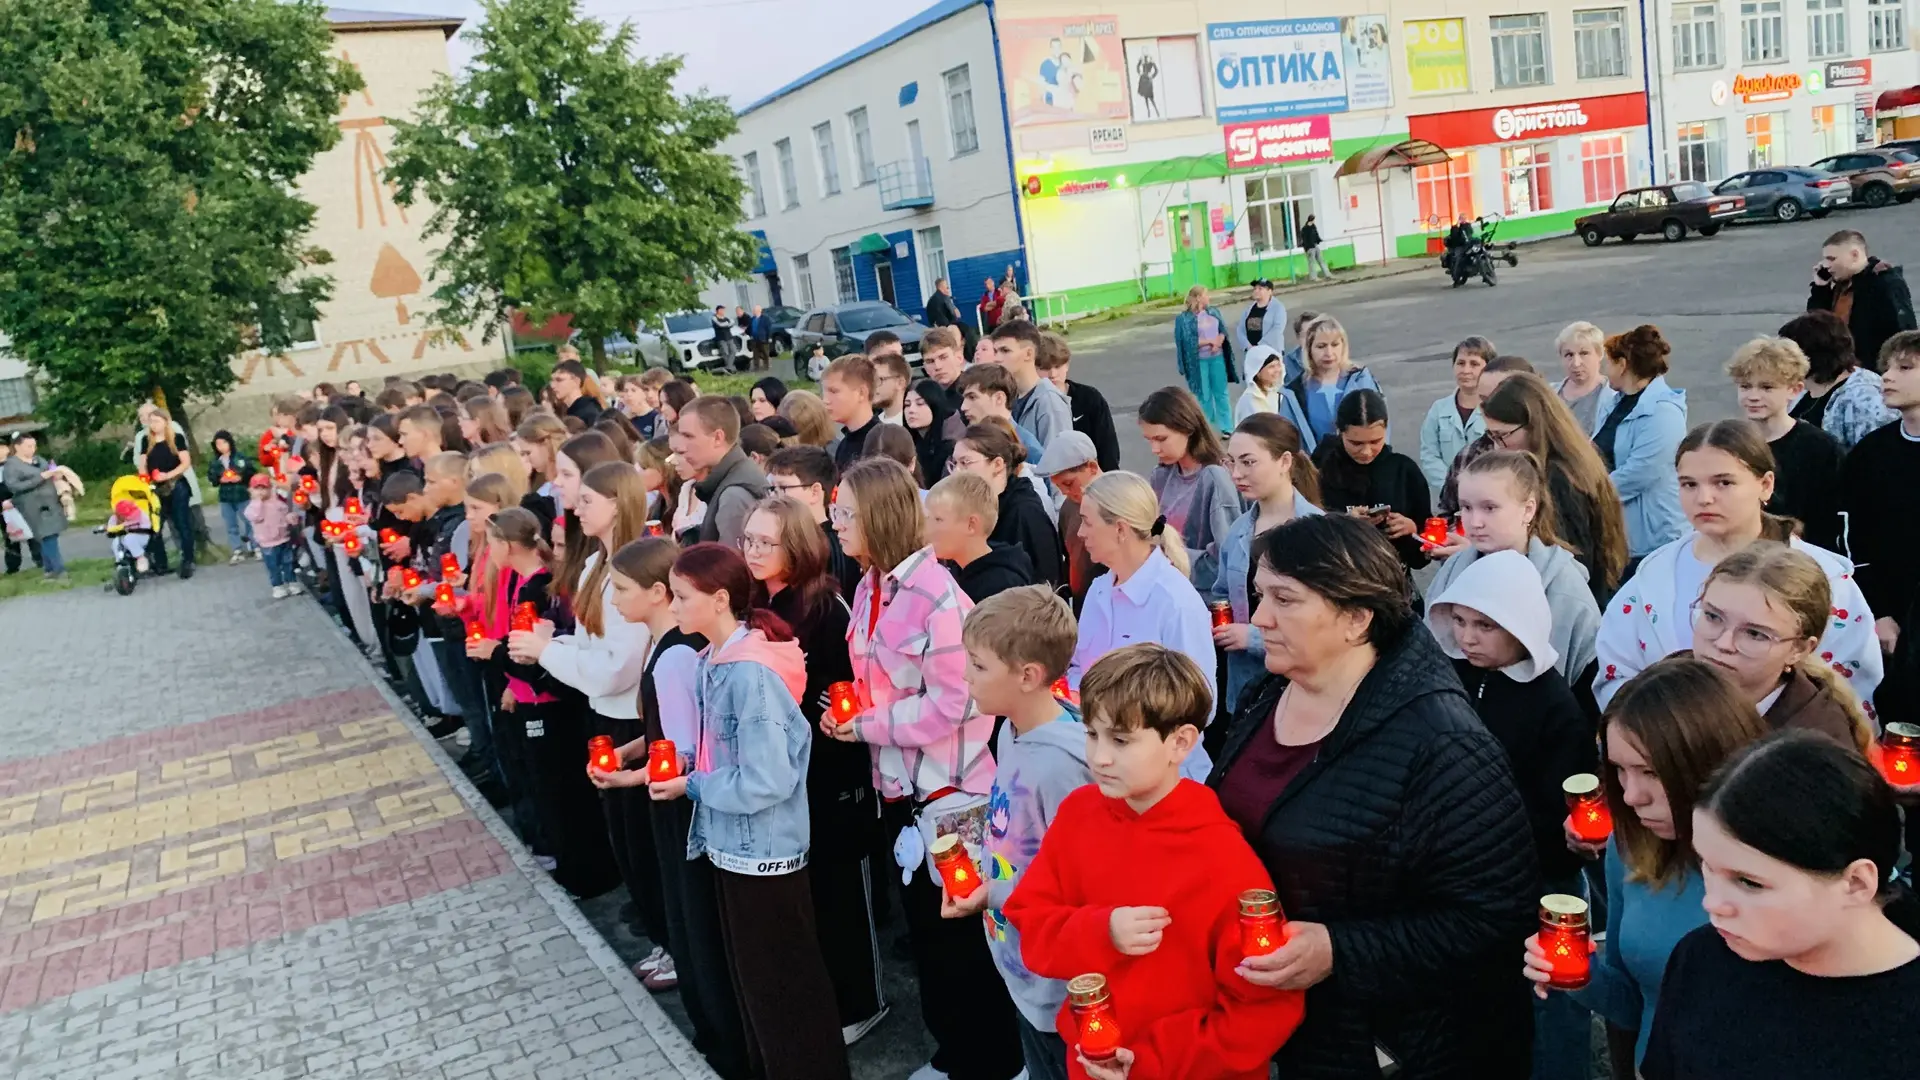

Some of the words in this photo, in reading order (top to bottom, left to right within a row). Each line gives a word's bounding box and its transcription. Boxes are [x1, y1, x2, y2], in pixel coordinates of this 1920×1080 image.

[1236, 23, 1294, 37] ОПТИЧЕСКИХ
[1295, 21, 1336, 33] САЛОНОВ
[1216, 50, 1341, 89] ОПТИКА
[1257, 121, 1312, 141] МАГНИТ
